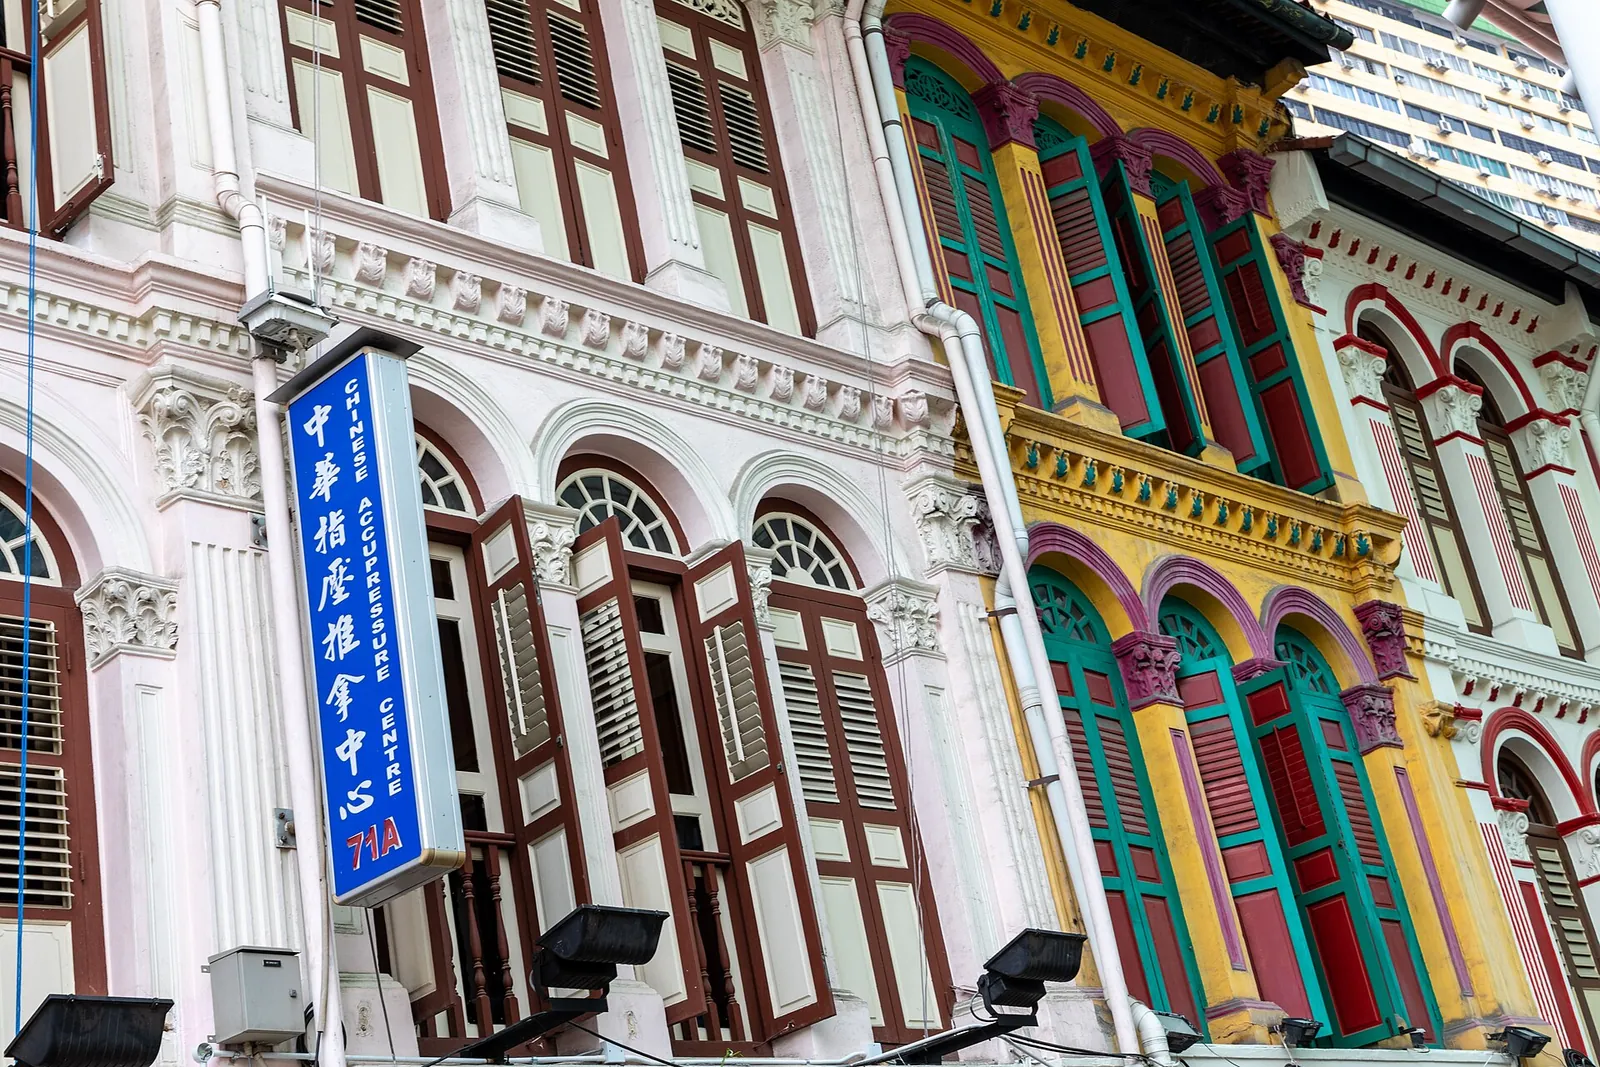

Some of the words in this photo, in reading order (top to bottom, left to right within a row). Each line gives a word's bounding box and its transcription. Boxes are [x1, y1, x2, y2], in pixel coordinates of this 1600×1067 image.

[303, 404, 374, 821] 中華指壓推拿中心
[345, 379, 368, 483] CHINESE
[358, 496, 391, 683] ACCUPRESSURE
[379, 697, 402, 797] CENTRE
[346, 816, 403, 871] 71A
